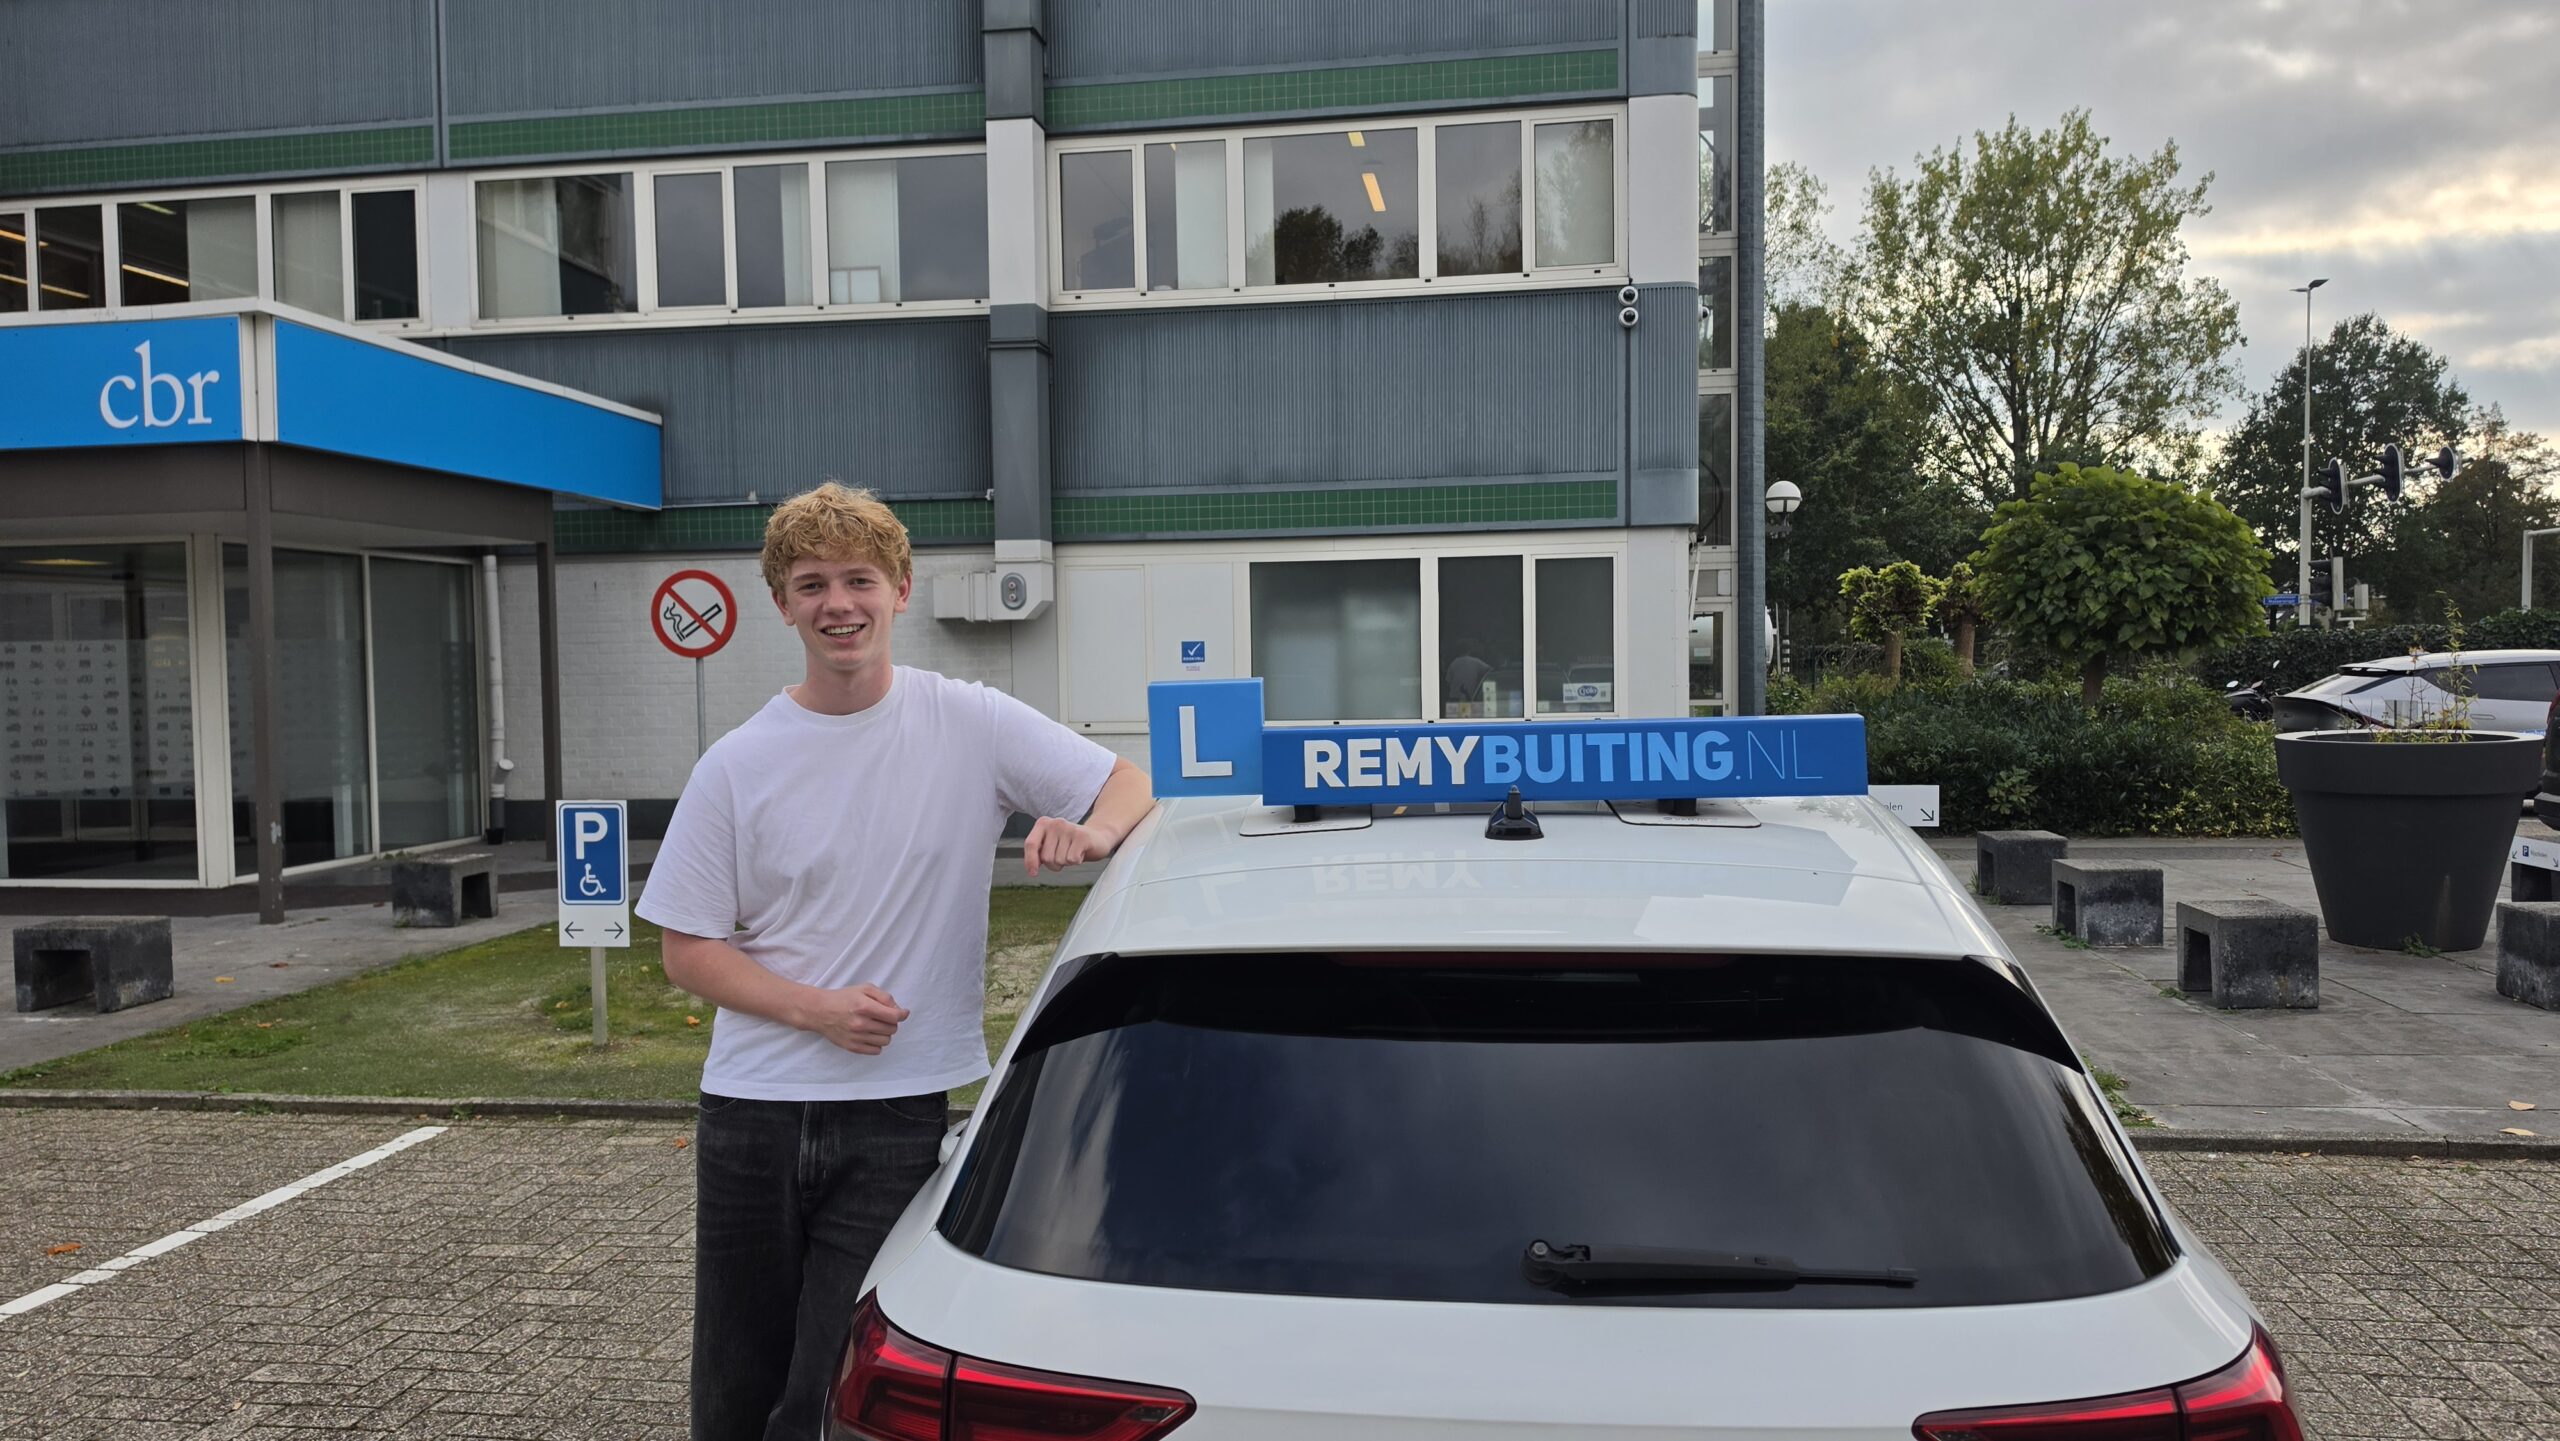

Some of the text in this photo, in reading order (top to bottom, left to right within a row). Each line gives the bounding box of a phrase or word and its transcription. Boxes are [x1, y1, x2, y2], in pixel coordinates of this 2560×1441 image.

[100, 339, 220, 429] cbr
[1179, 705, 1232, 777] L
[1303, 730, 1823, 788] REMYBUITING.NL
[575, 811, 608, 860] P
